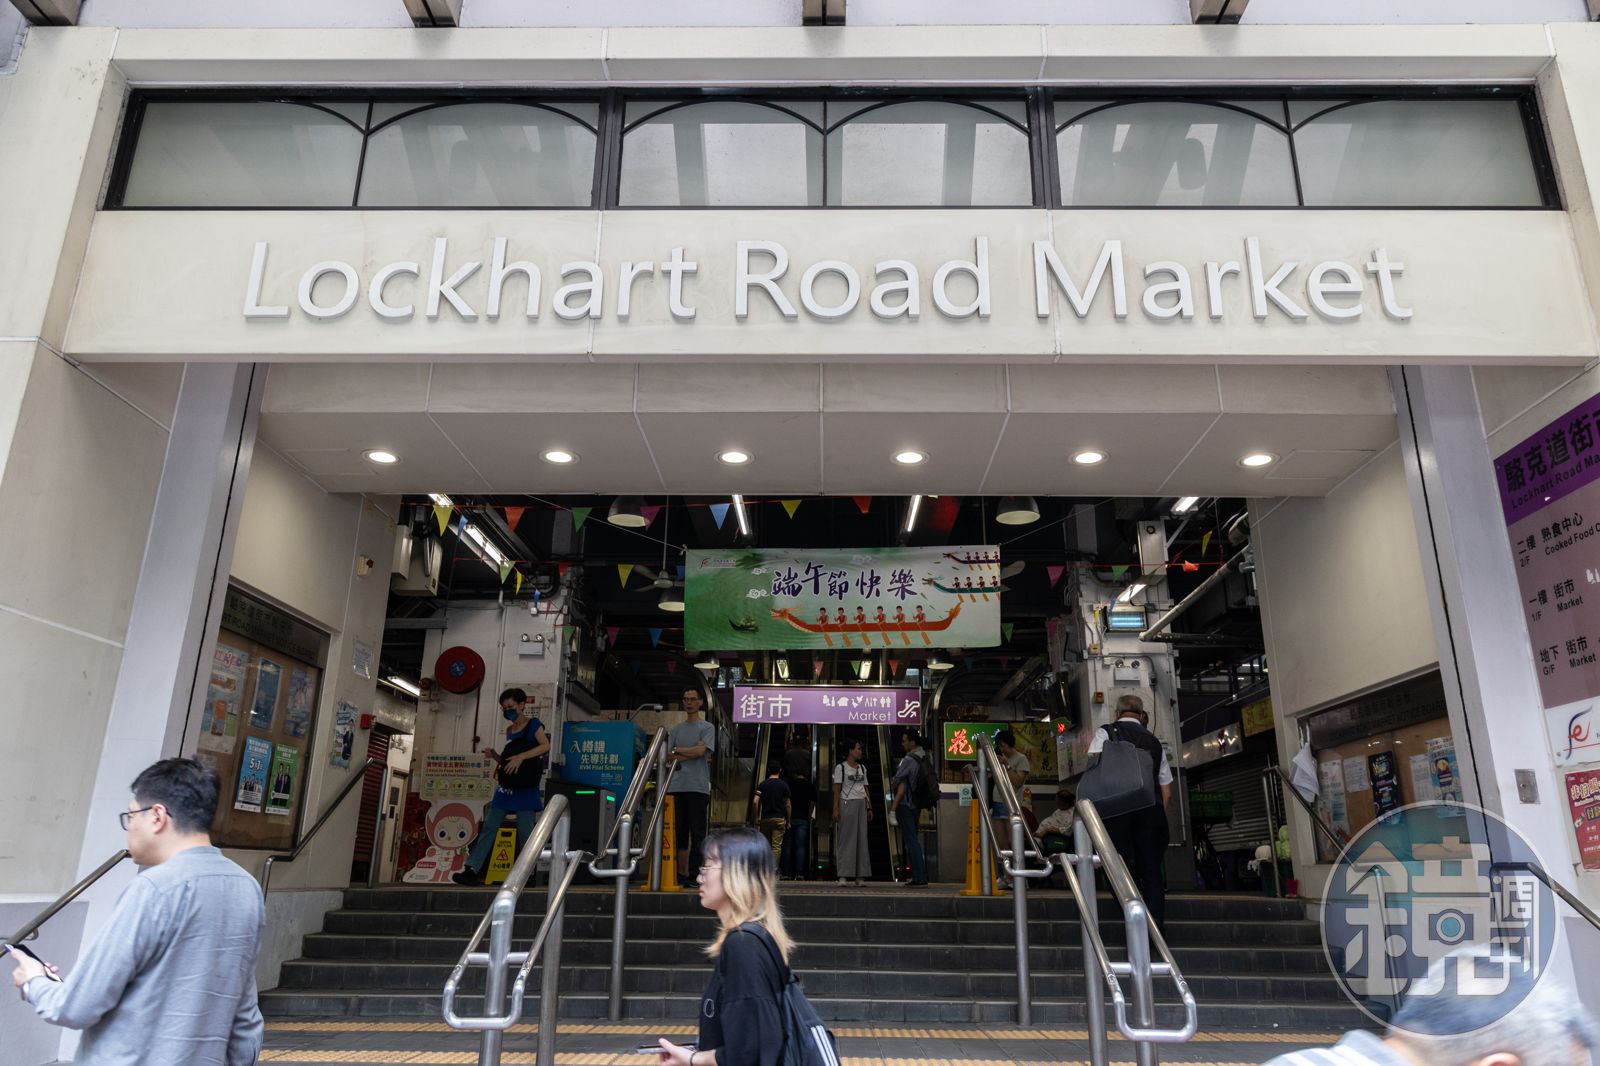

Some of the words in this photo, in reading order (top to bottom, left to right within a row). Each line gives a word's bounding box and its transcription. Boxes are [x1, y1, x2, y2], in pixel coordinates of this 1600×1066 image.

[242, 236, 698, 321] Lockhart
[734, 235, 992, 320] Road
[1033, 236, 1413, 322] Market
[1511, 477, 1555, 510] Lockhart
[1556, 462, 1583, 486] Road
[1516, 534, 1537, 555] 二樓
[1541, 512, 1584, 543] 熟食中心
[1519, 555, 1531, 568] 2/F
[1545, 536, 1574, 556] Cooked
[1574, 526, 1594, 542] Food
[771, 561, 919, 601] 端午節快樂
[1528, 589, 1549, 606] 一樓
[1553, 578, 1575, 600] 街市
[1531, 610, 1543, 622] 1/F
[1556, 595, 1584, 613] Market
[1539, 645, 1560, 664] 地下
[1565, 635, 1589, 656] 街市
[1542, 664, 1556, 676] G/F
[1568, 653, 1597, 669] Market
[740, 693, 793, 720] 街市
[848, 709, 893, 722] Market
[948, 728, 974, 756] 花
[580, 753, 619, 765] 先導計劃
